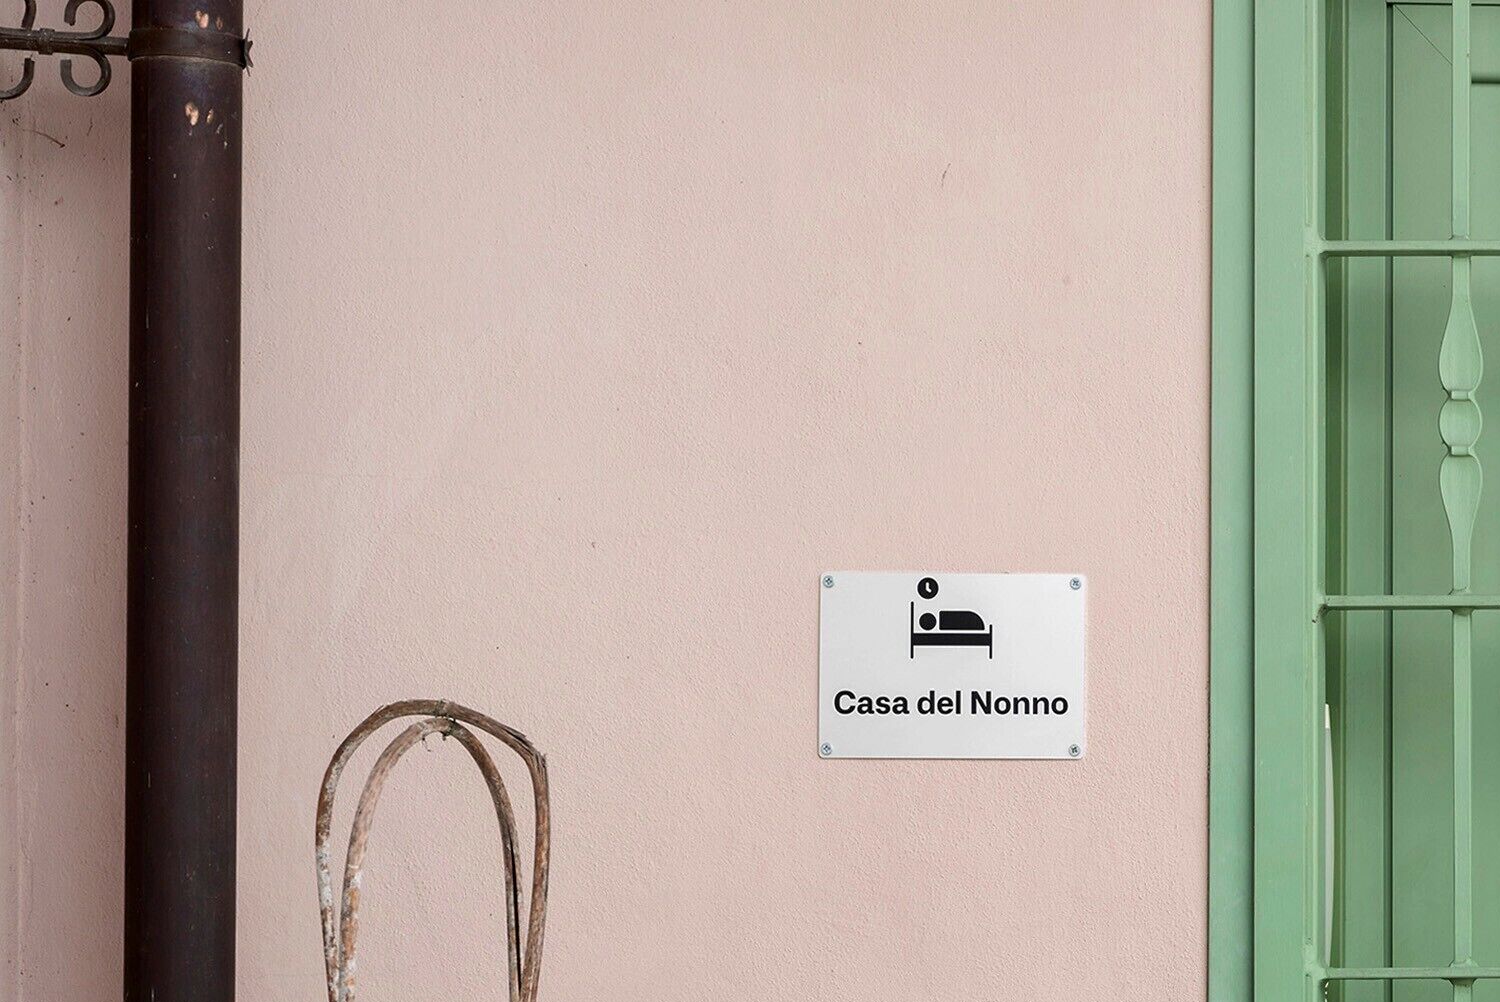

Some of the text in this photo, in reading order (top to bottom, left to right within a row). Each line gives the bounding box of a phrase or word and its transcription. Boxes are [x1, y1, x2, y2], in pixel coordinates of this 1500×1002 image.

[834, 690, 1069, 715] Casa del Nonno
